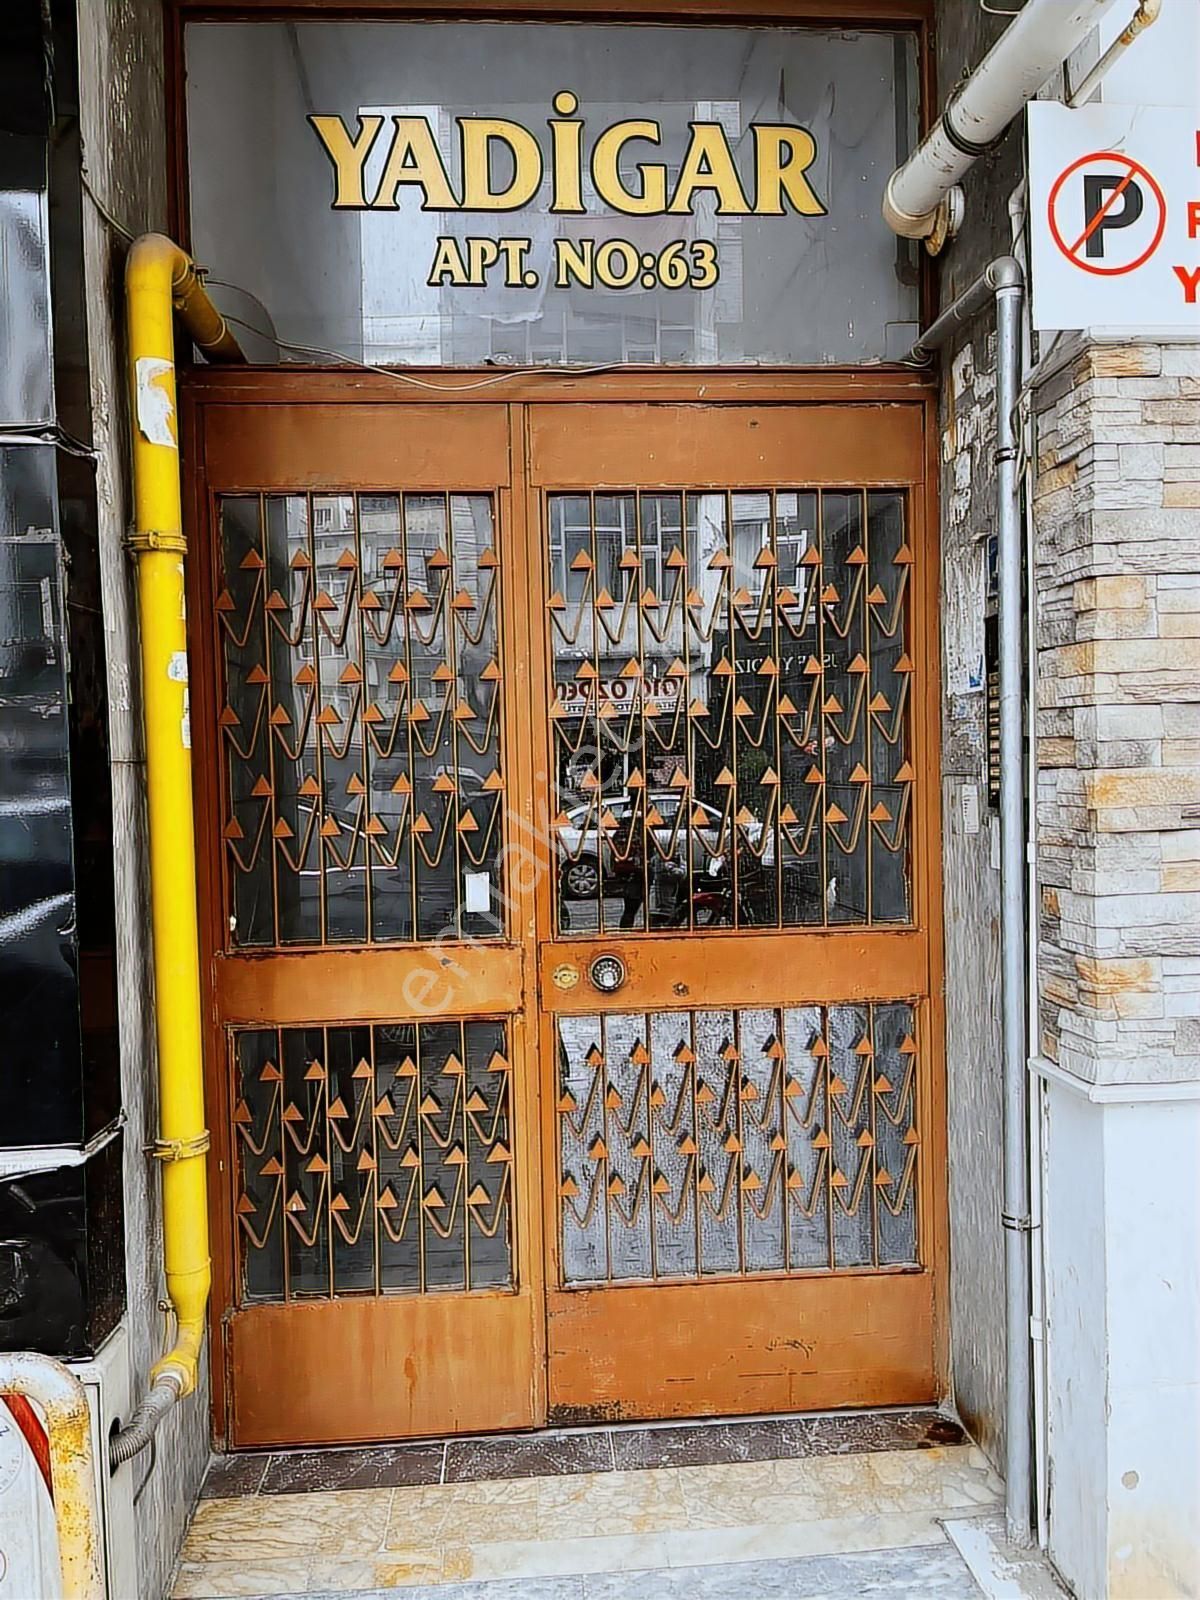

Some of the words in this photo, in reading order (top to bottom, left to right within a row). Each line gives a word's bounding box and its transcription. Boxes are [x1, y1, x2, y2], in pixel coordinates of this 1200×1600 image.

[306, 90, 828, 216] YADİGAR
[427, 237, 538, 288] APT.
[555, 238, 720, 290] NO:63
